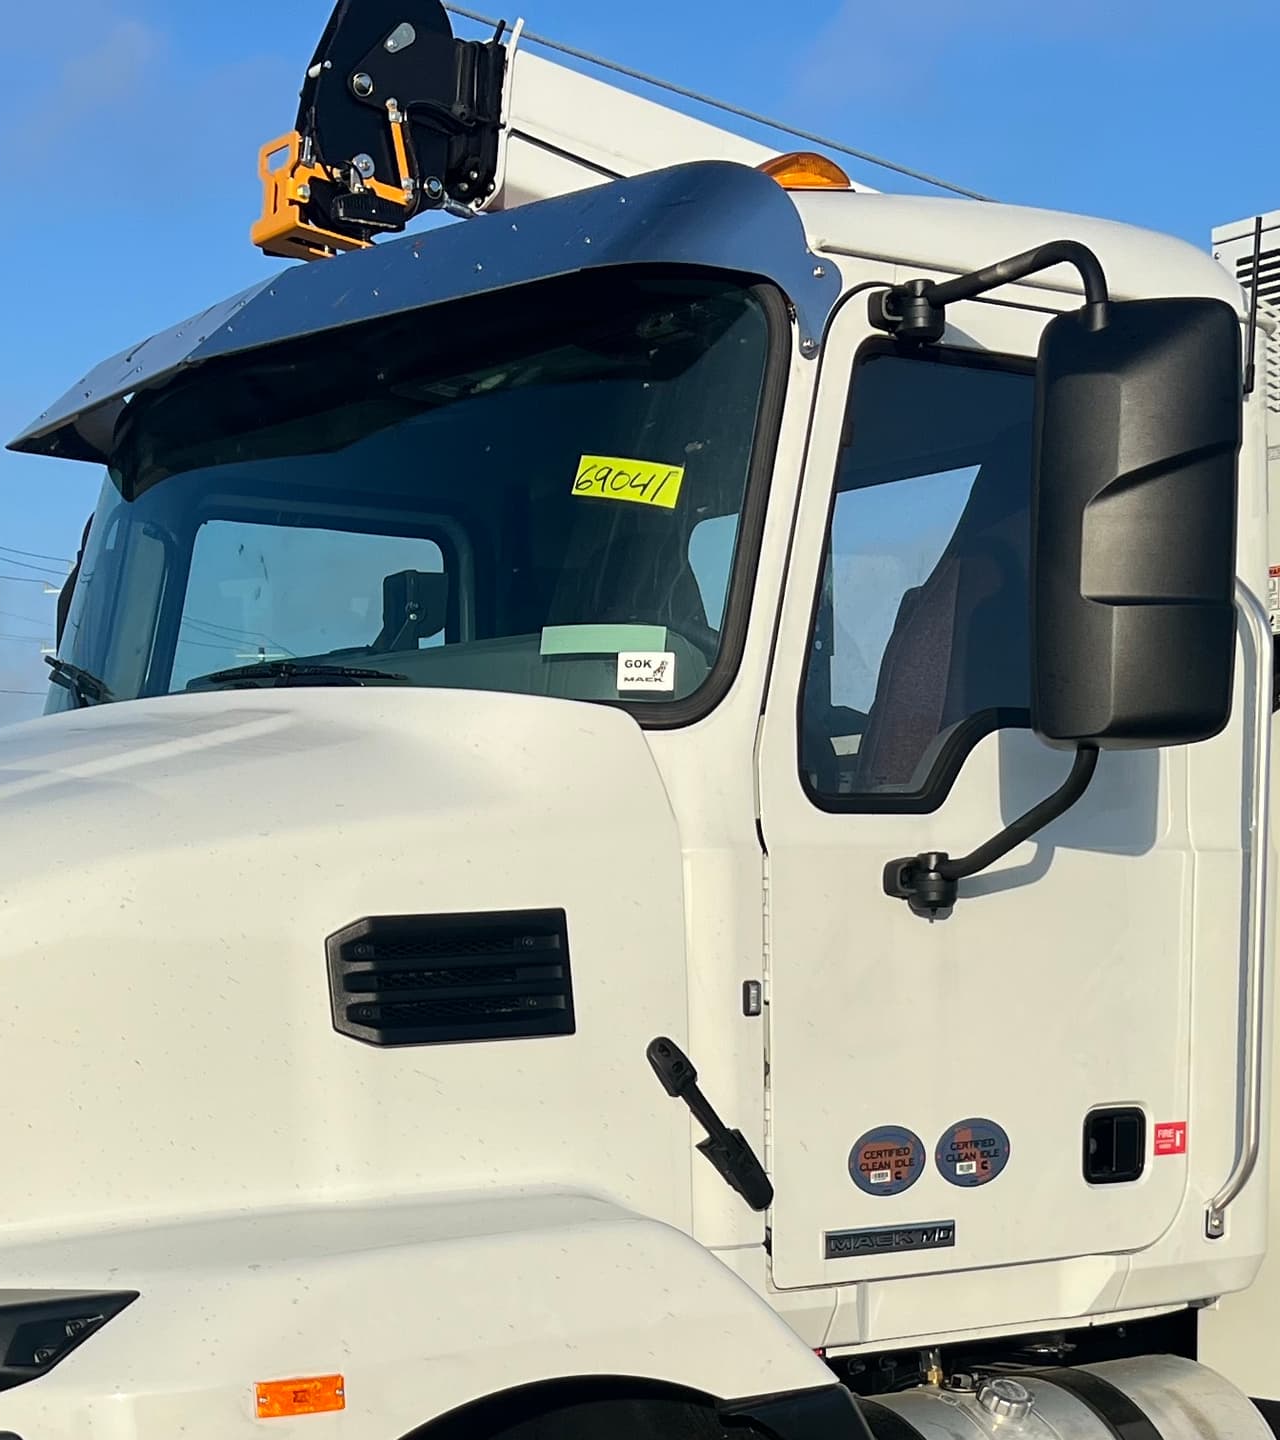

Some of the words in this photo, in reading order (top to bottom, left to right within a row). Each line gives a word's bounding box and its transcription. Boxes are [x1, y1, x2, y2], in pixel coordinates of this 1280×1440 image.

[624, 659, 652, 669] GOK
[1157, 1128, 1175, 1138] FIRE
[950, 1138, 996, 1150] CERTIFIED
[863, 1147, 910, 1160] CERTIFIED
[946, 1151, 976, 1162] CLEAN
[980, 1148, 1000, 1158] IDLE
[859, 1161, 891, 1171] CLEAN
[894, 1157, 916, 1168] IDLE
[831, 1232, 913, 1251] MACK
